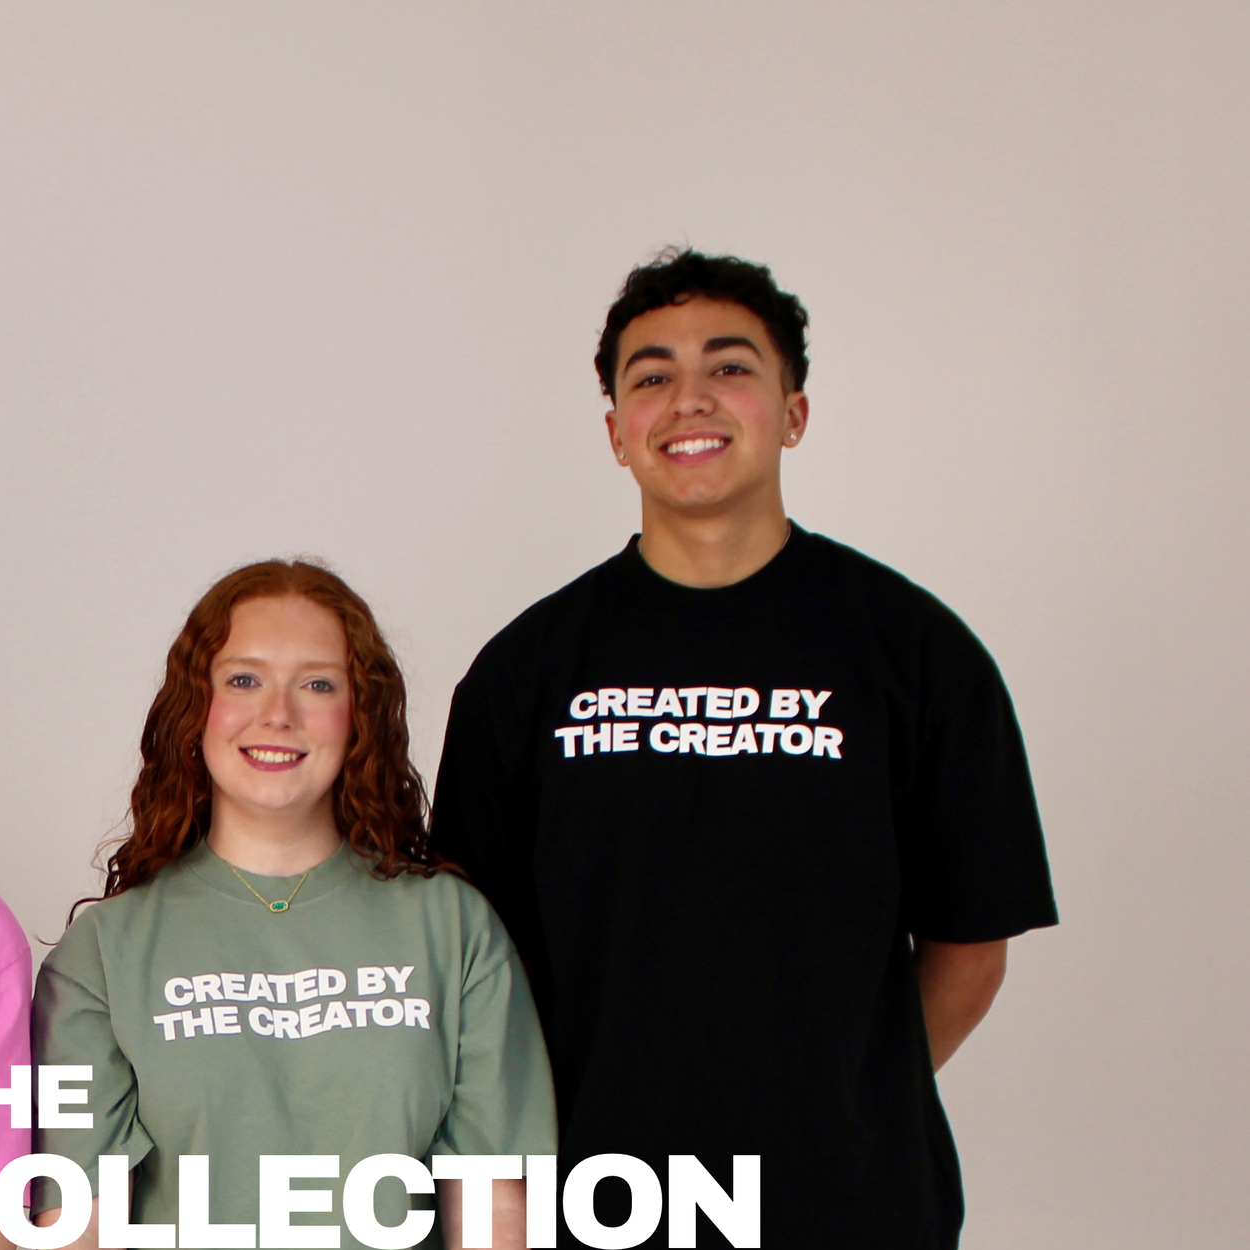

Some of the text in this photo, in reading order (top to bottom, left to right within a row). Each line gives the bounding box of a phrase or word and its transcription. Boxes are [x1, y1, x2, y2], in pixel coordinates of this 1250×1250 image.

[568, 686, 832, 720] CREATED BY
[554, 722, 844, 759] THE CREATOR
[163, 965, 416, 1007] CREATED BY
[152, 997, 431, 1042] THE CREATOR
